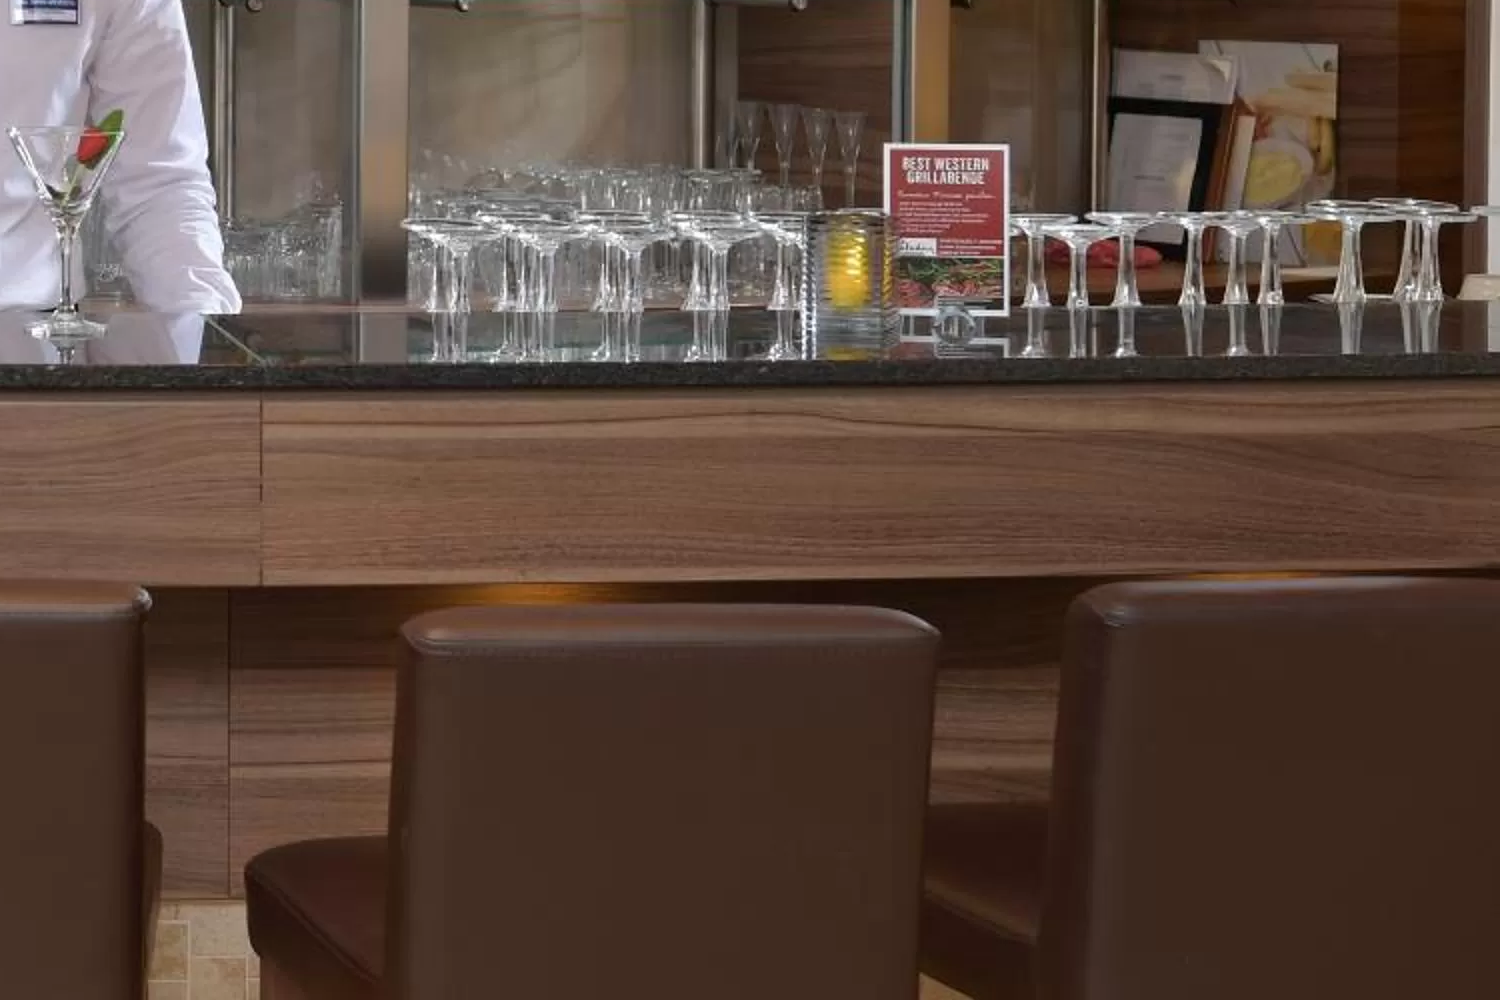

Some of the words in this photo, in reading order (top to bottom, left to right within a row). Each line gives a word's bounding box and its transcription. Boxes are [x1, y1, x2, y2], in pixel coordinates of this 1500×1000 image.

[903, 157, 931, 171] BEST
[934, 157, 990, 172] WESTERN
[906, 171, 986, 185] GRILLABENDE
